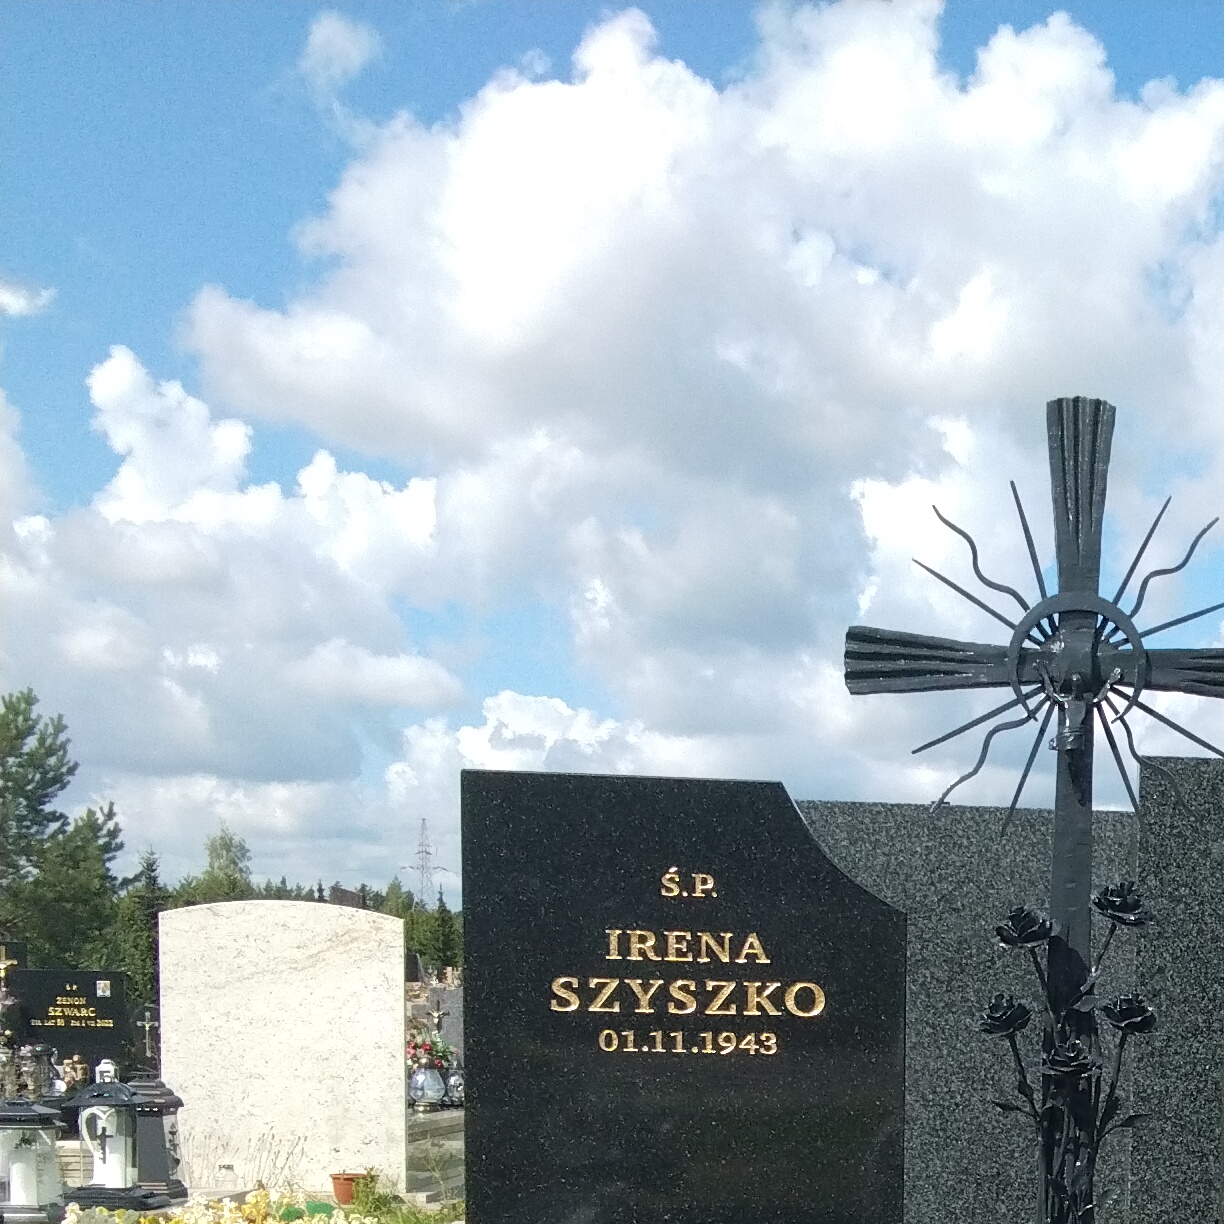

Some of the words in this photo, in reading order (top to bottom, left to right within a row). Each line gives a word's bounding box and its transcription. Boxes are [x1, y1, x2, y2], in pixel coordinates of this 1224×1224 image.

[661, 867, 718, 898] Ś.P.
[605, 929, 771, 964] IRENA
[56, 997, 87, 1005] ZENON
[550, 976, 826, 1017] SZYSZKO
[48, 1007, 96, 1017] SZWARC
[598, 1029, 778, 1055] 01.11.1943
